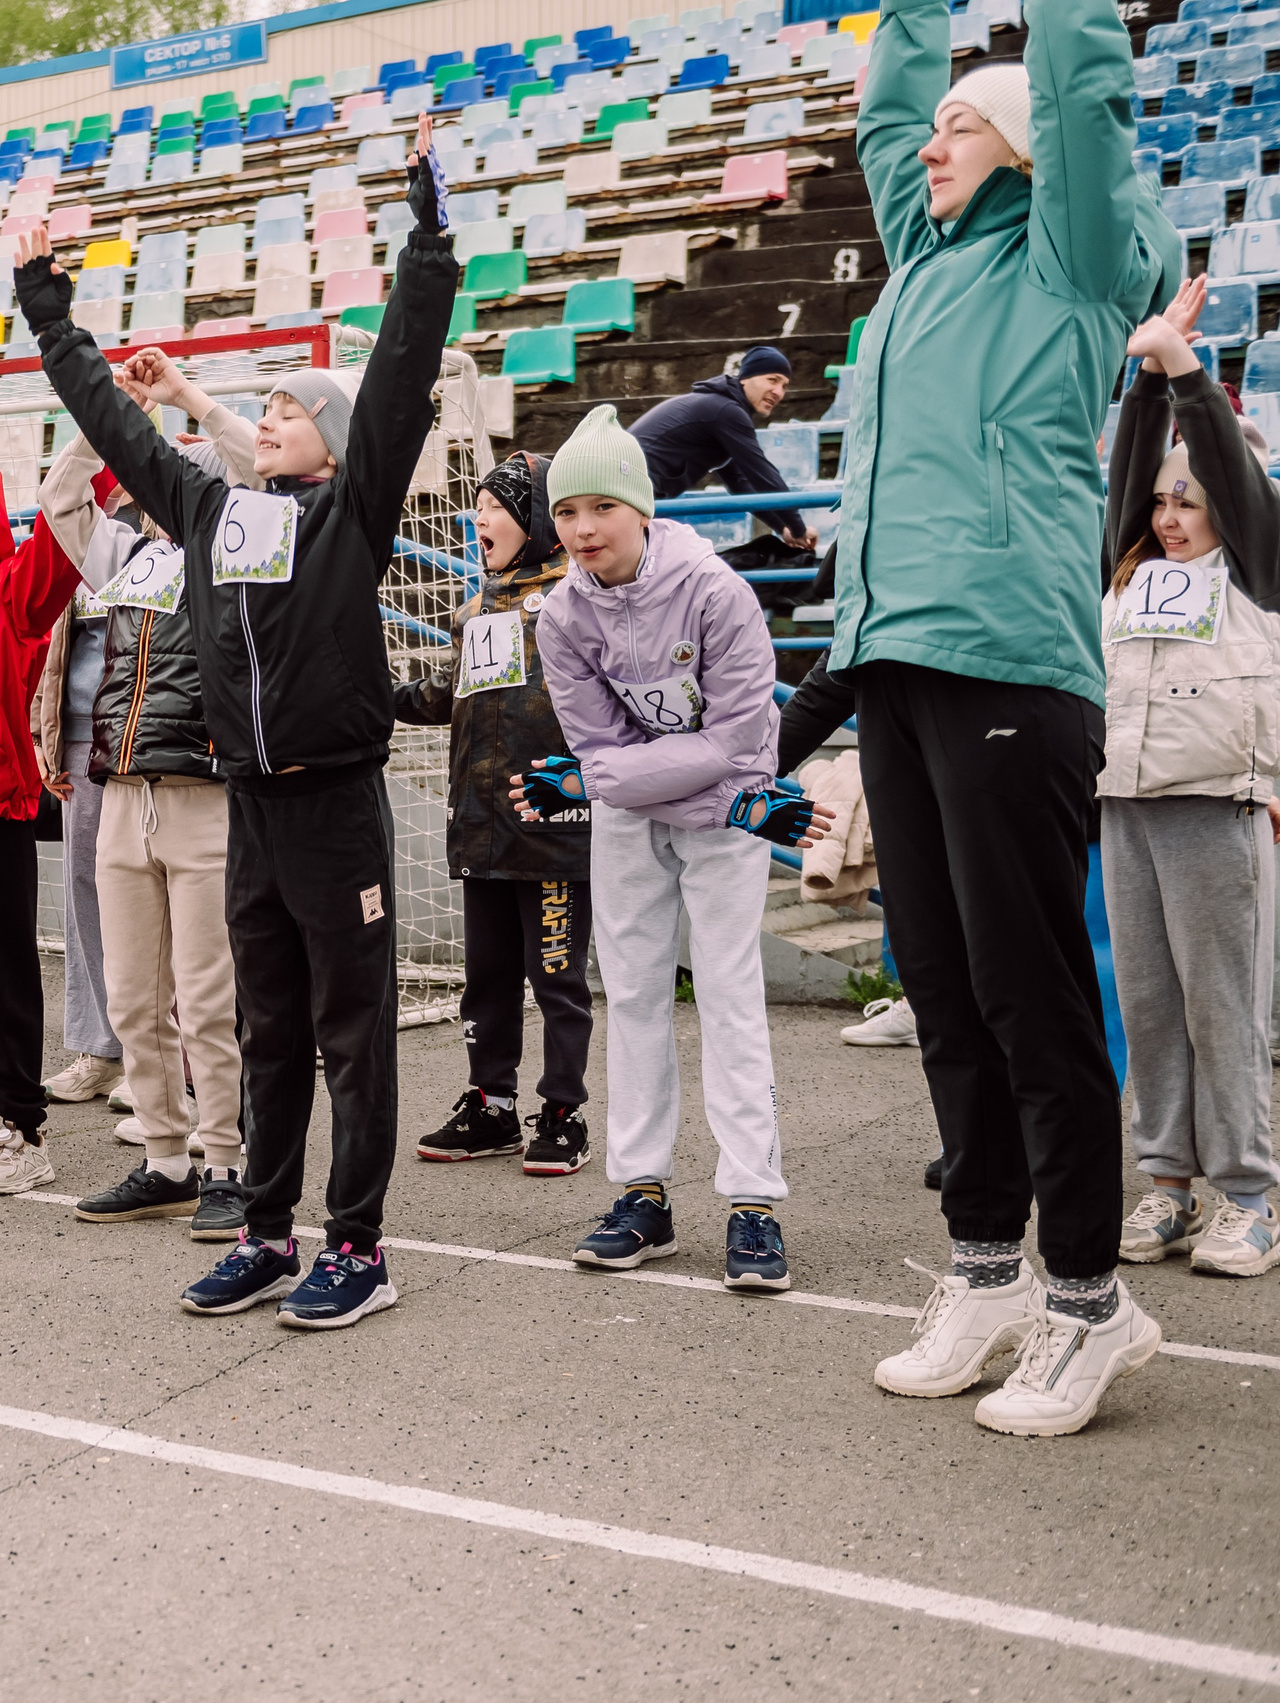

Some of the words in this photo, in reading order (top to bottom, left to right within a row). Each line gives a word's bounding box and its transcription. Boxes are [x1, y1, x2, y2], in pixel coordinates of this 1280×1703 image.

[144, 40, 202, 63] СЕКТОР
[204, 33, 231, 52] №6
[833, 248, 859, 282] 8
[777, 303, 800, 338] 7
[224, 499, 245, 553] 6
[1136, 569, 1190, 616] 12
[468, 625, 498, 670] 11
[622, 688, 683, 726] 18
